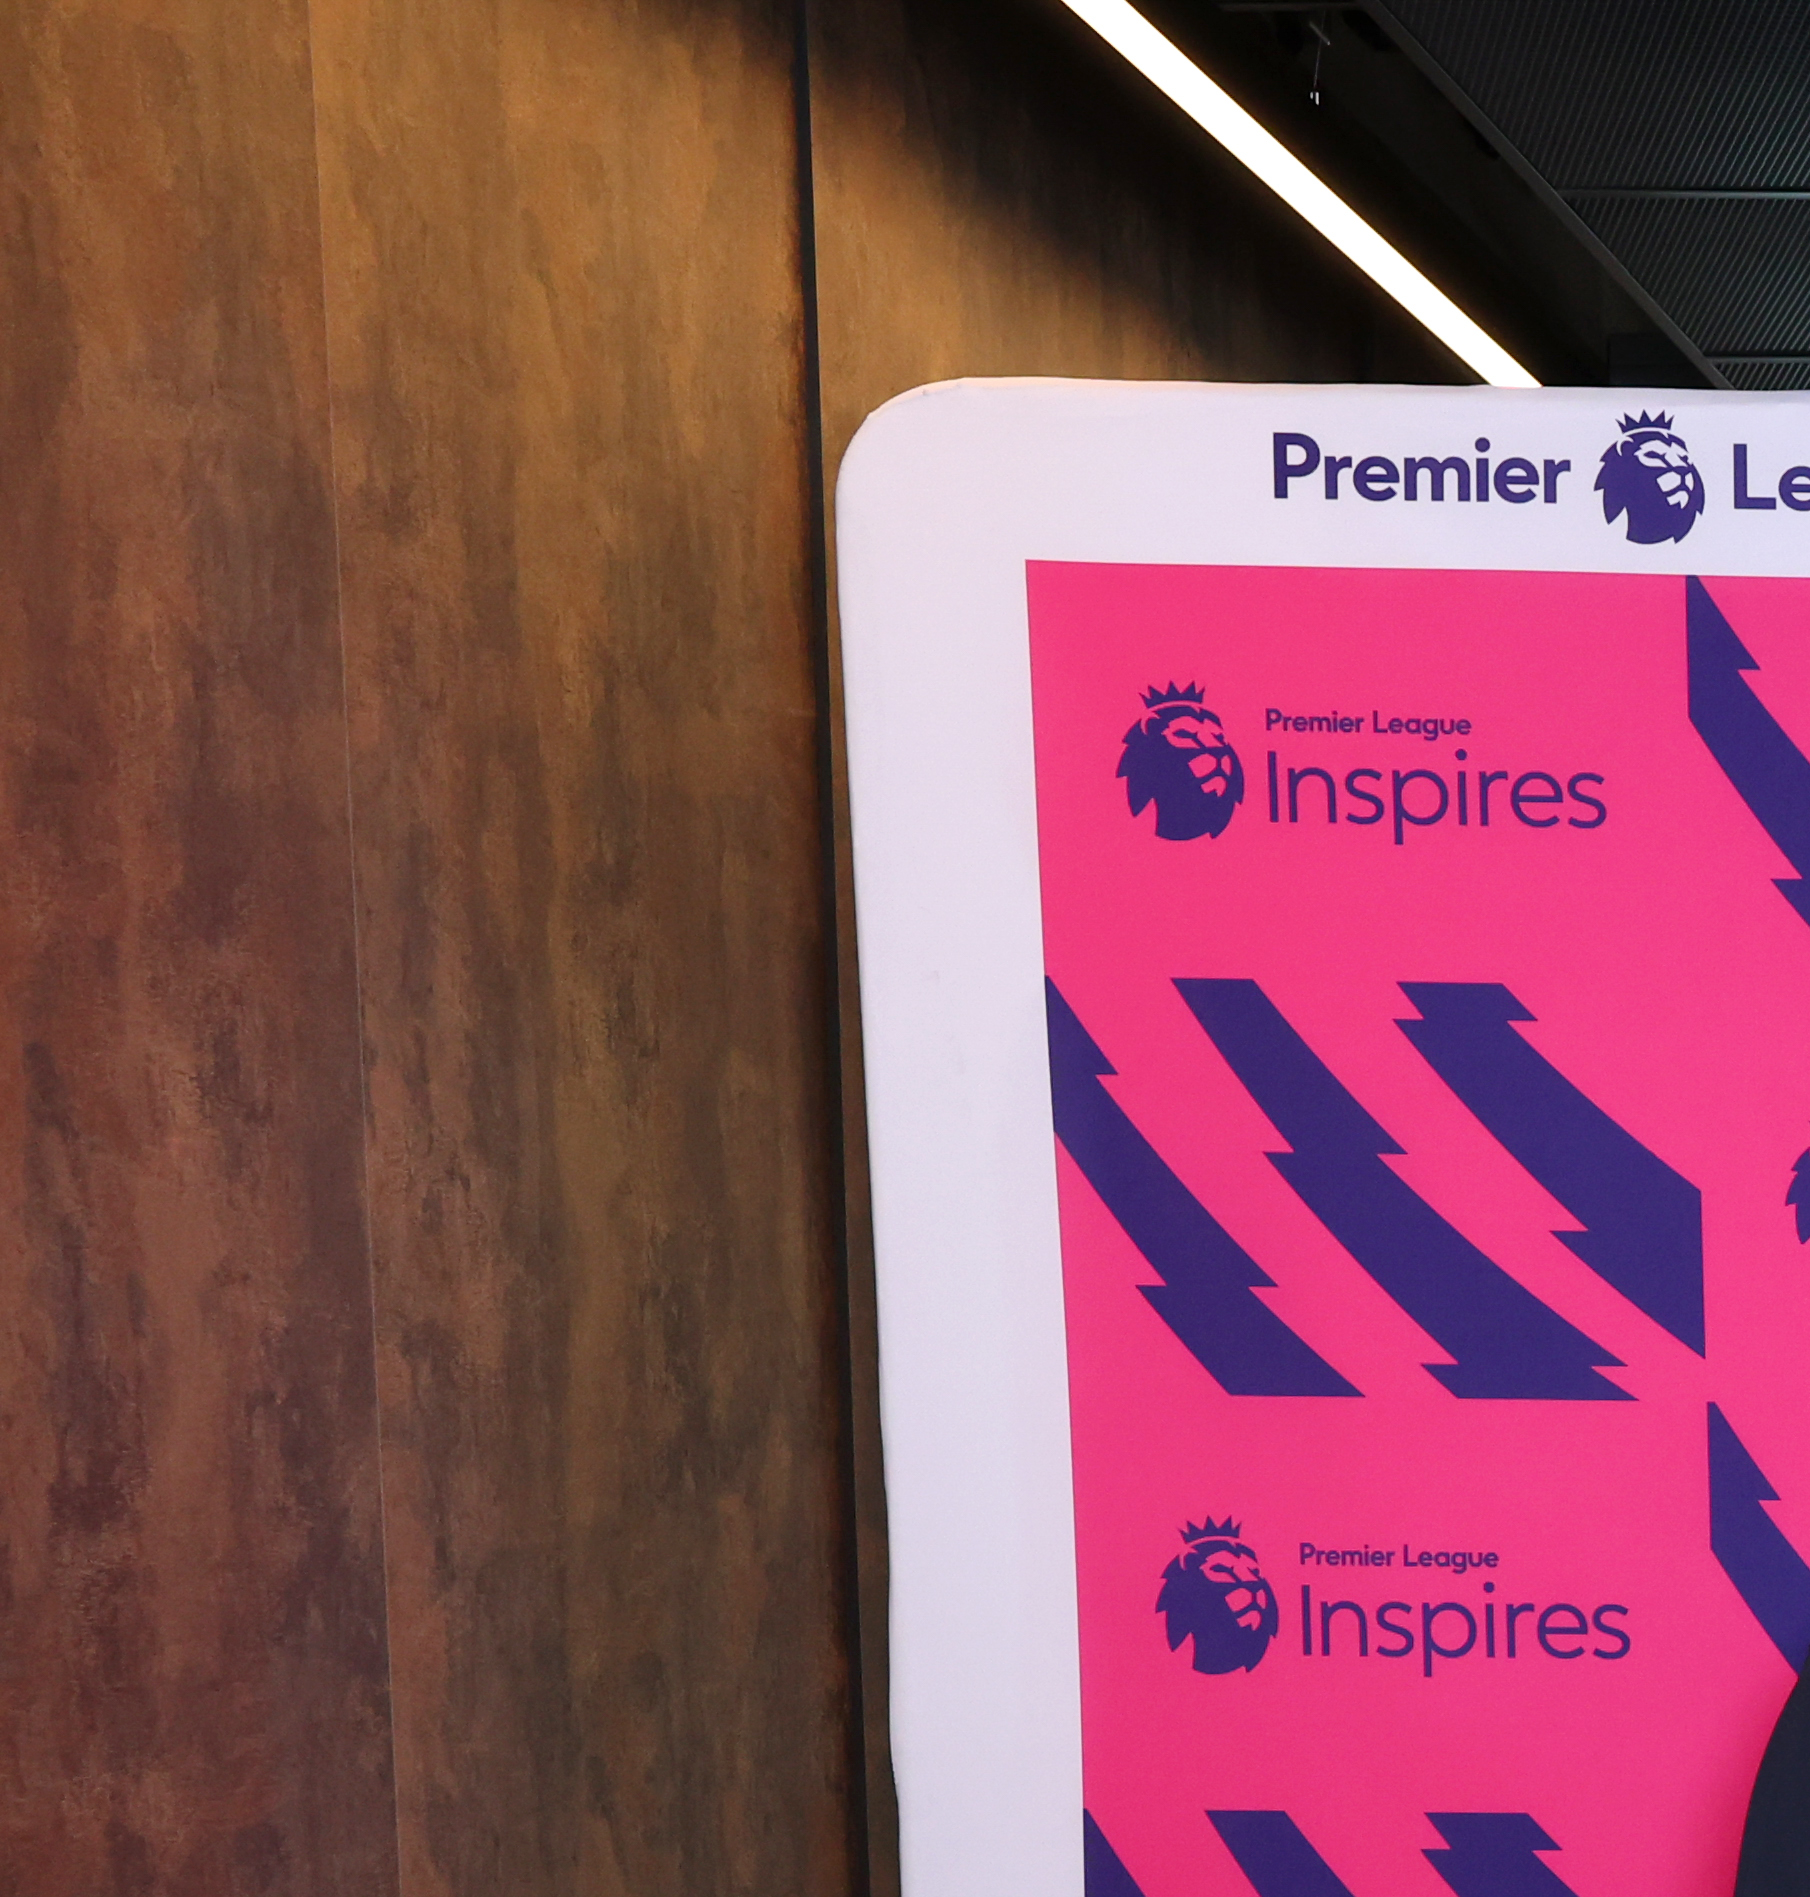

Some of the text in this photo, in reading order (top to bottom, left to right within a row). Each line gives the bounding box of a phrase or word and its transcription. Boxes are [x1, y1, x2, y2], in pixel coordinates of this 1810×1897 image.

[1272, 431, 1571, 504] Premier
[1265, 708, 1471, 741] Premier League
[1267, 748, 1608, 845] Inspires
[1300, 1542, 1499, 1574] Premier League
[1300, 1581, 1631, 1678] Inspires
